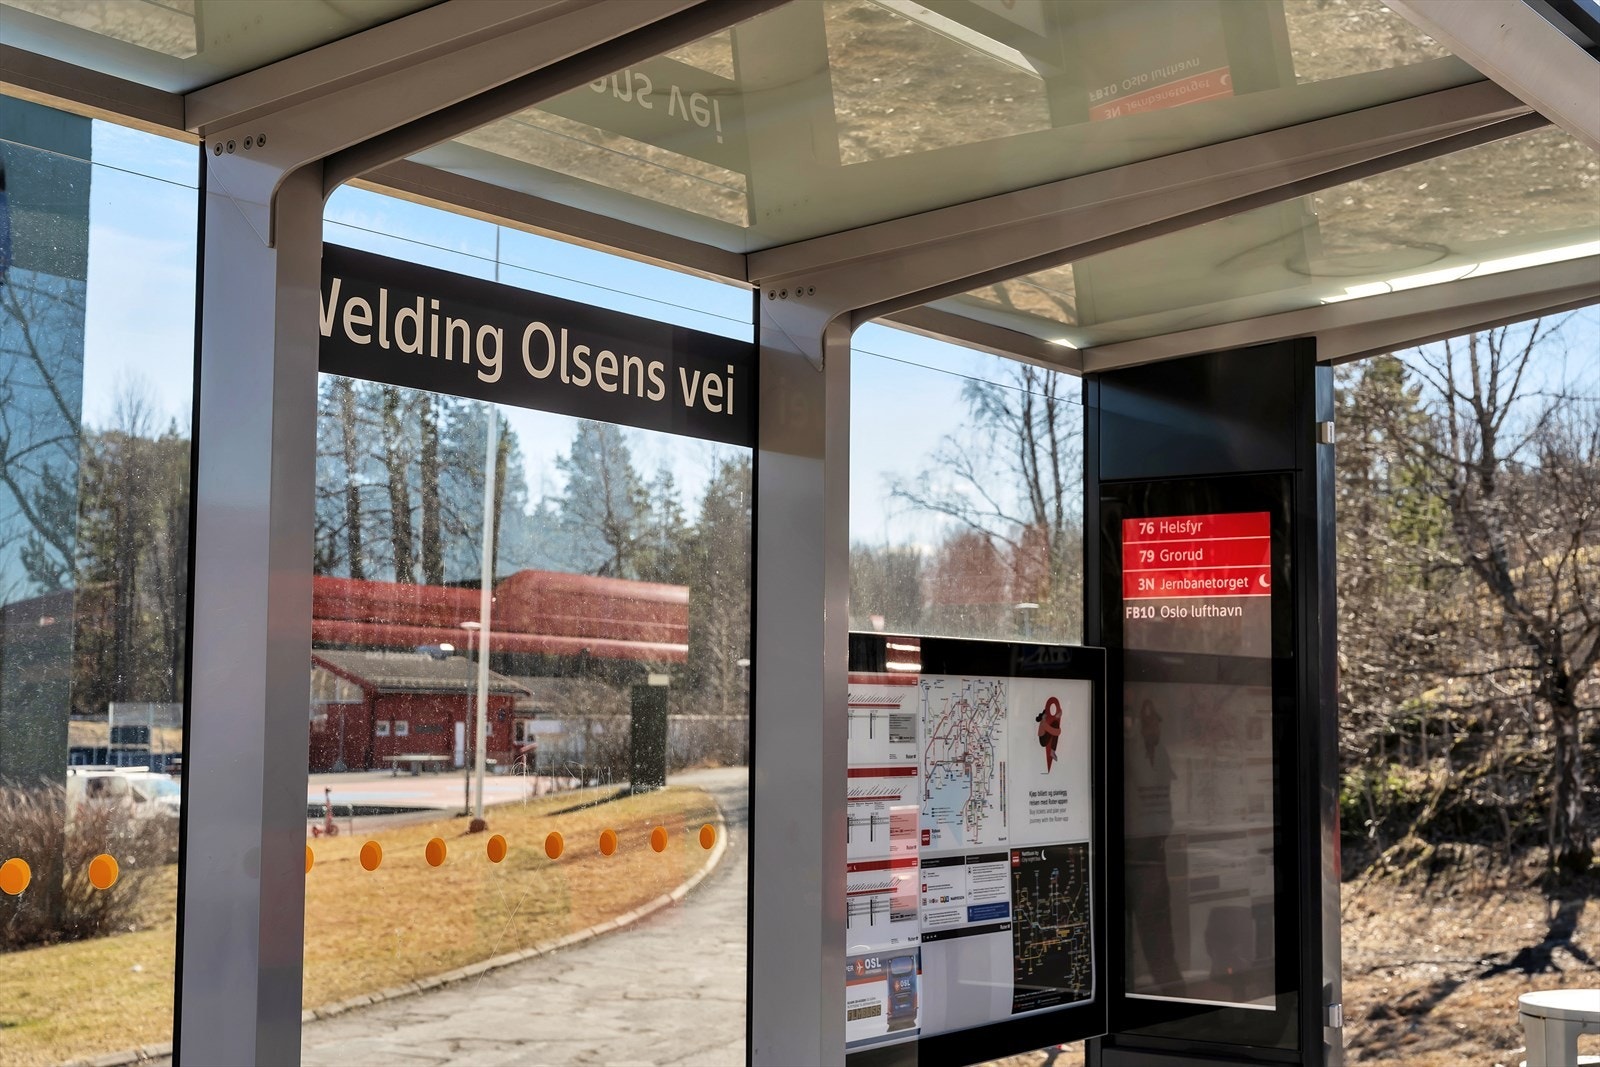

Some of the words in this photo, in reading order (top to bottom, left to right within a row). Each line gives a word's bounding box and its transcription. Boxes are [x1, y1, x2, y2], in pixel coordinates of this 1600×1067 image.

[521, 321, 666, 402] Olsens
[678, 364, 735, 416] vei
[1138, 522, 1155, 535] 76
[1159, 520, 1203, 535] Helsfyr
[1138, 550, 1155, 563] 79
[1159, 548, 1203, 562] Grorud
[1138, 578, 1155, 591] 3N
[1159, 576, 1249, 592] Jernbanetorget
[1125, 606, 1155, 619] FB10
[1160, 605, 1188, 619] Oslo
[1191, 604, 1243, 618] lufthavn
[864, 957, 882, 969] OSL
